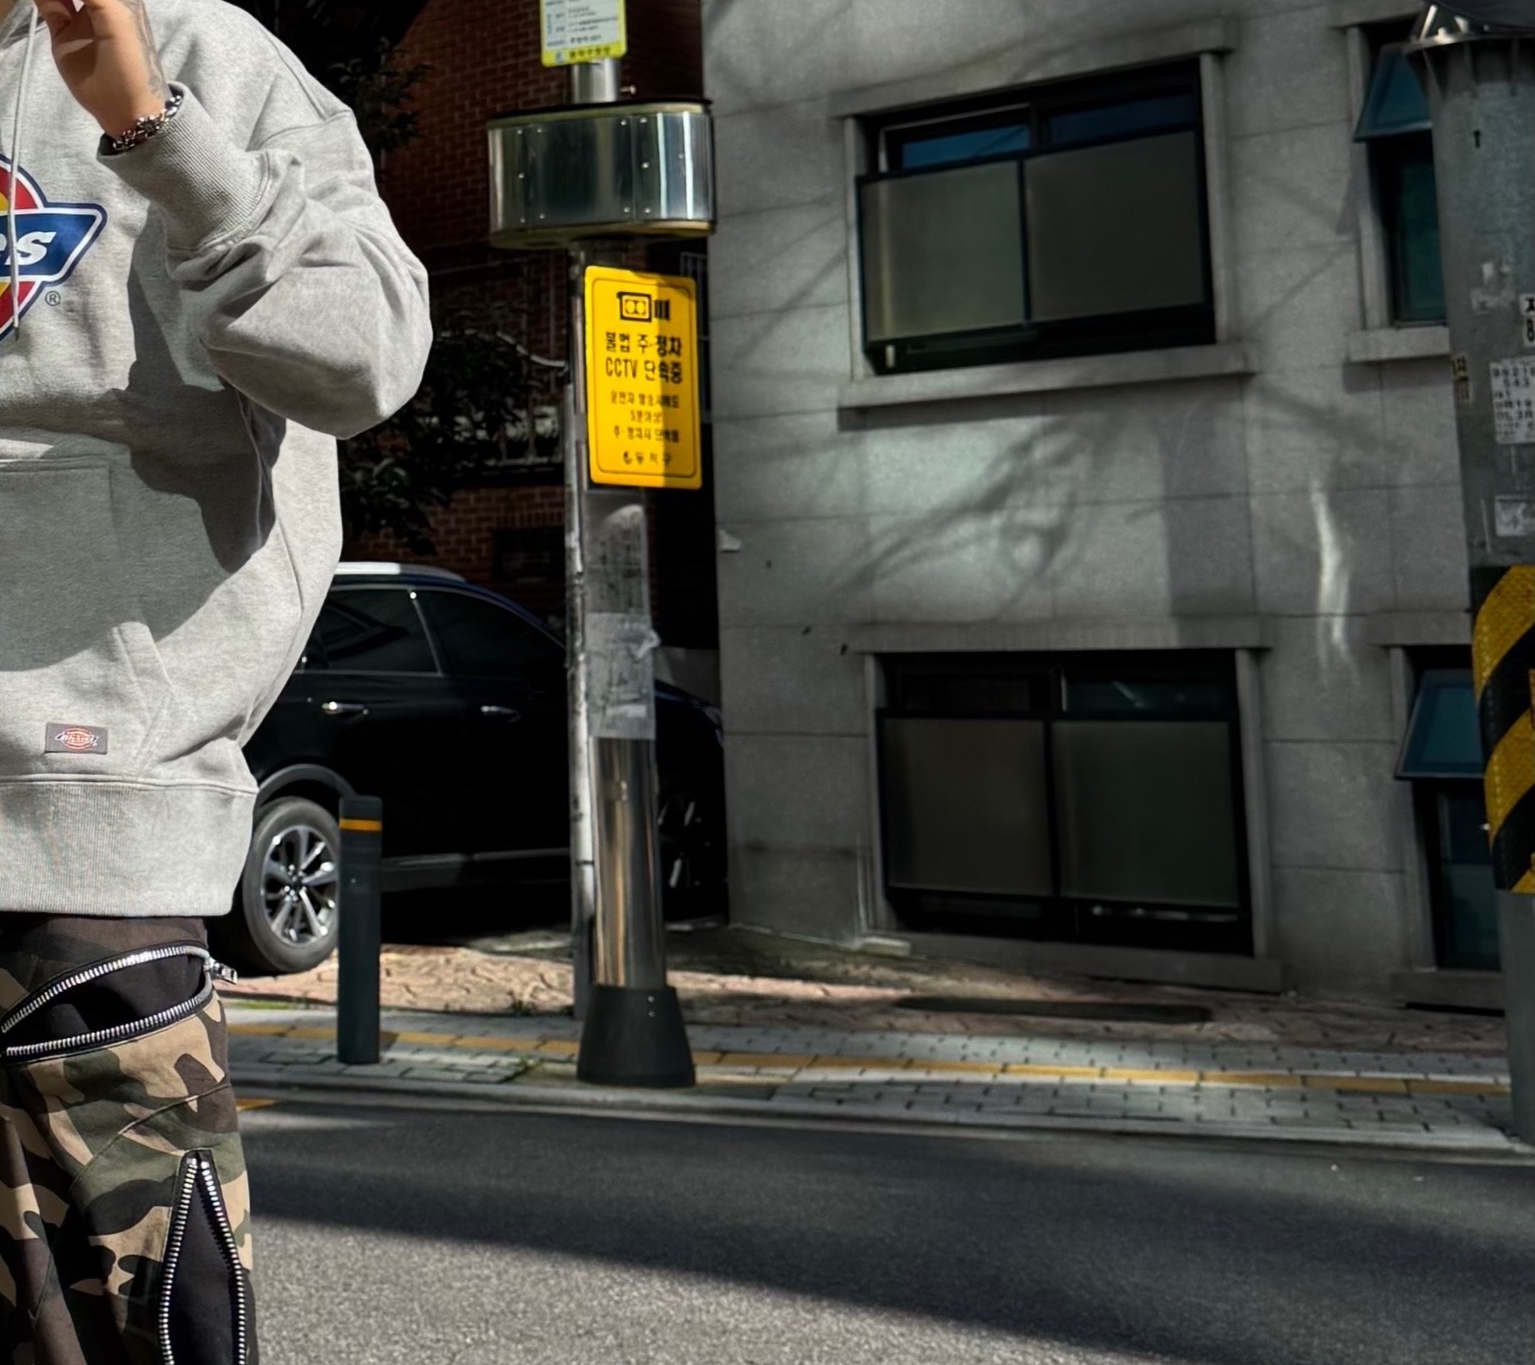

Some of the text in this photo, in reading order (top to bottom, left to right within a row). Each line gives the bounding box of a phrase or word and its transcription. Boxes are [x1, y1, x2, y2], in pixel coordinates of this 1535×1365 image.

[606, 332, 630, 353] 불법
[606, 357, 682, 384] CCTV 단속중
